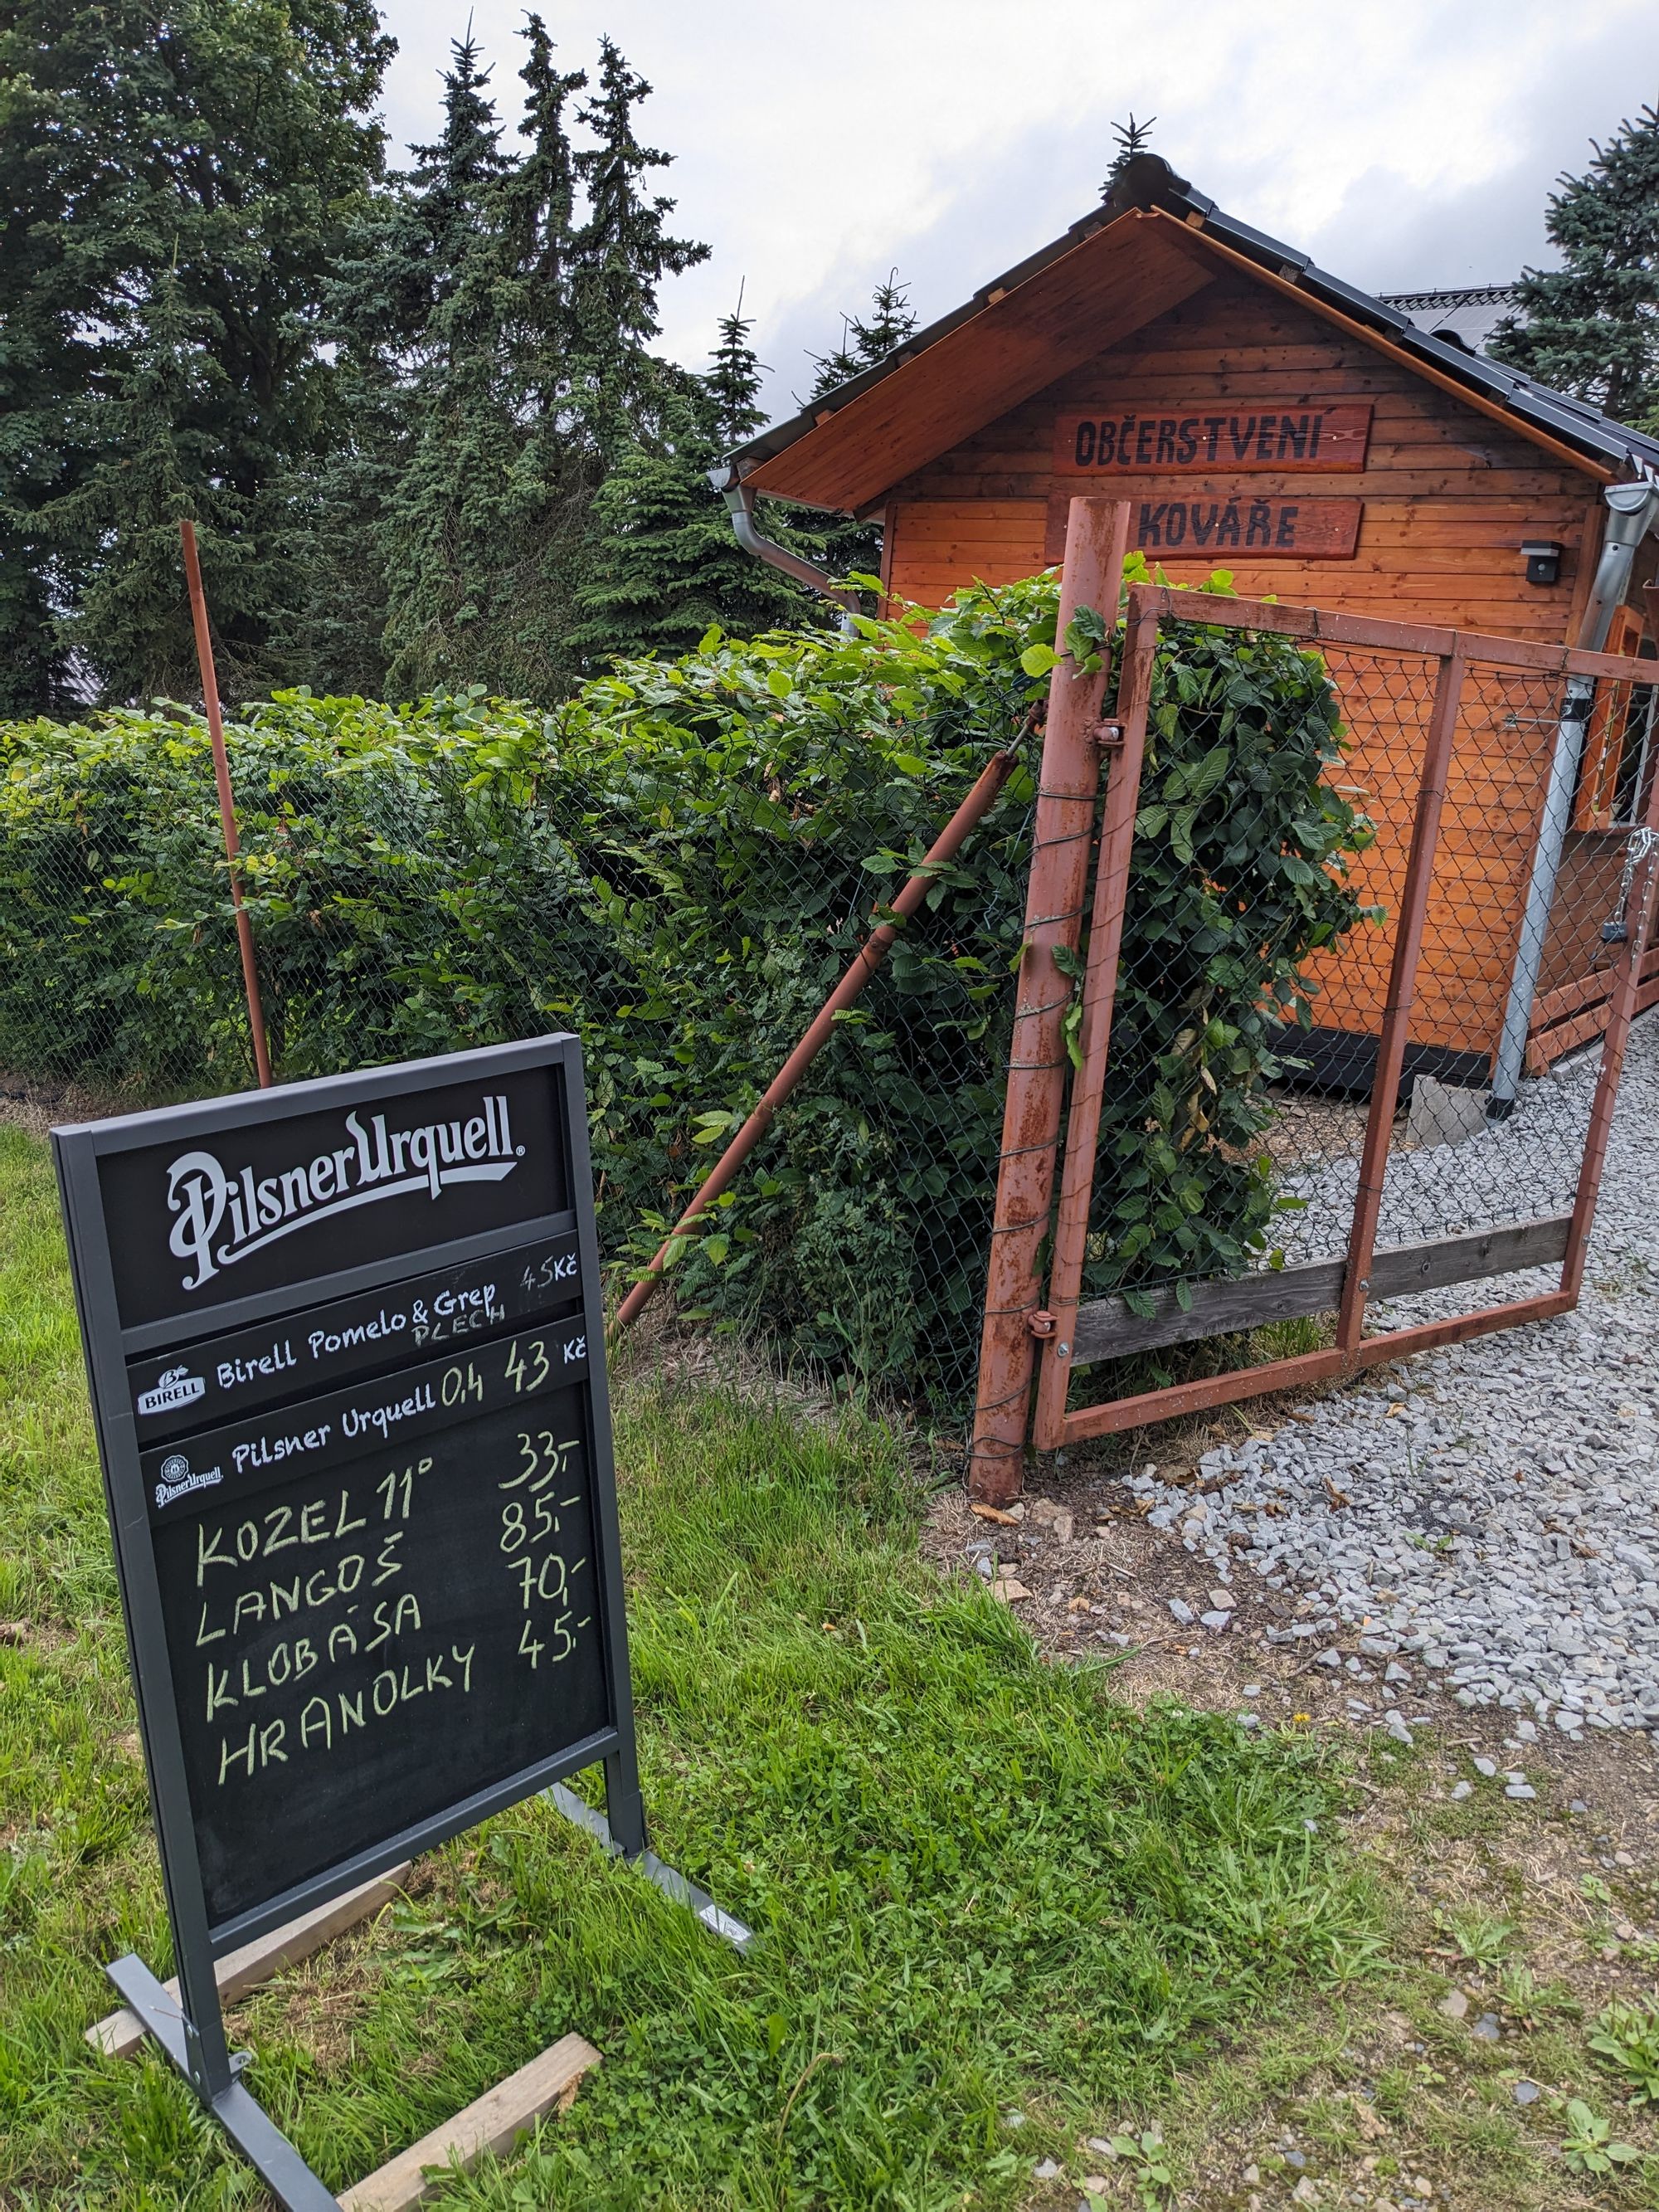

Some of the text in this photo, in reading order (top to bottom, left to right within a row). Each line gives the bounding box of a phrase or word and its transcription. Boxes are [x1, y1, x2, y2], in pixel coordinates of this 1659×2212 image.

[1075, 407, 1337, 466] OBČERSTVENÍ
[1137, 496, 1299, 548] KOVÁŘE
[167, 1095, 513, 1291] Pilsner Urquell
[217, 1341, 297, 1388] Birell
[308, 1310, 406, 1358] Pomelo
[412, 1299, 429, 1324] &
[433, 1284, 496, 1317] Grep
[411, 1303, 505, 1347] PLECH
[145, 1382, 200, 1410] BIRELL
[231, 1425, 331, 1474] Pilsner
[342, 1383, 436, 1439] Urquell
[504, 1340, 550, 1394] 43
[563, 1335, 586, 1364] Kč
[197, 1490, 367, 1586] KOZEL
[207, 1593, 421, 1722] KLOBÁSA
[218, 1644, 476, 1786] HRANOLKY
